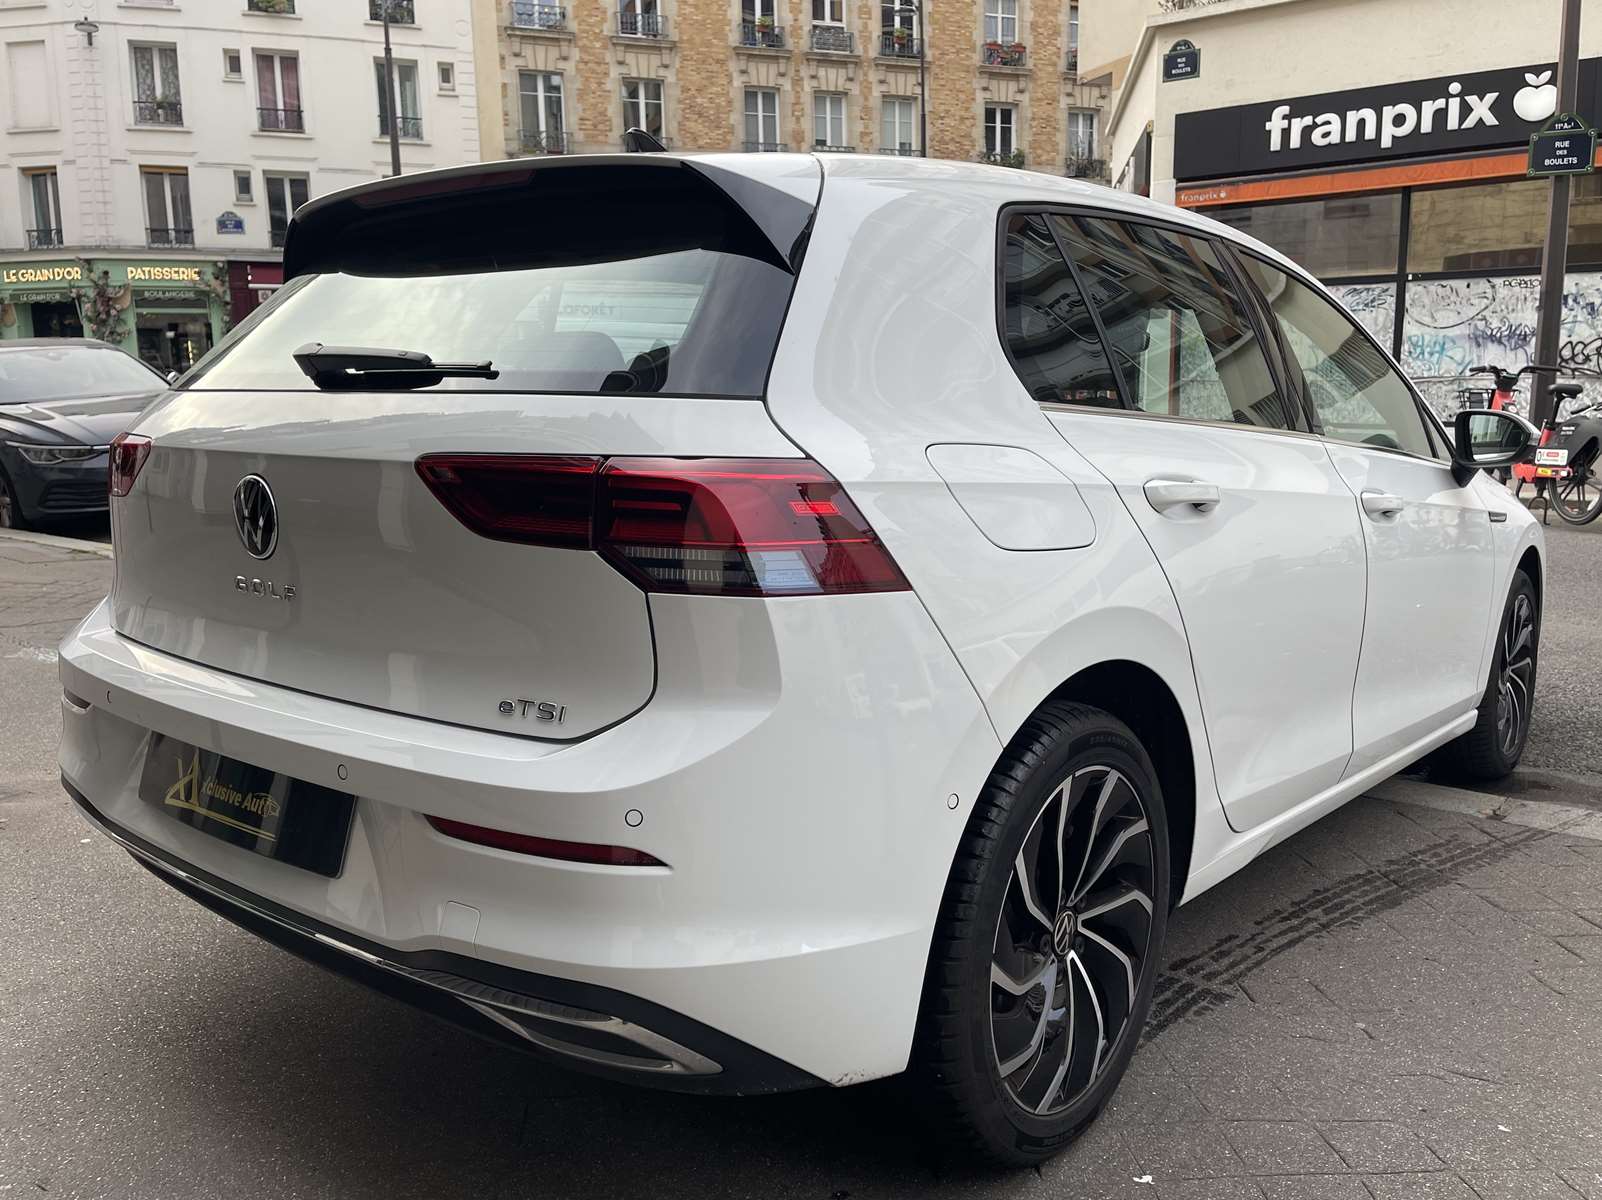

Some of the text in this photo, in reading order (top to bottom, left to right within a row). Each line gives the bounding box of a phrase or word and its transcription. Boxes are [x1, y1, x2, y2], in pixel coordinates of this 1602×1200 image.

[1265, 82, 1500, 151] franprix
[1555, 140, 1570, 148] RUE
[1544, 157, 1578, 166] BOULETS
[1181, 192, 1217, 201] franprix
[3, 270, 17, 283] LE
[127, 266, 201, 280] PATISSERIE
[235, 575, 296, 601] GOLF
[499, 698, 567, 724] eTSI
